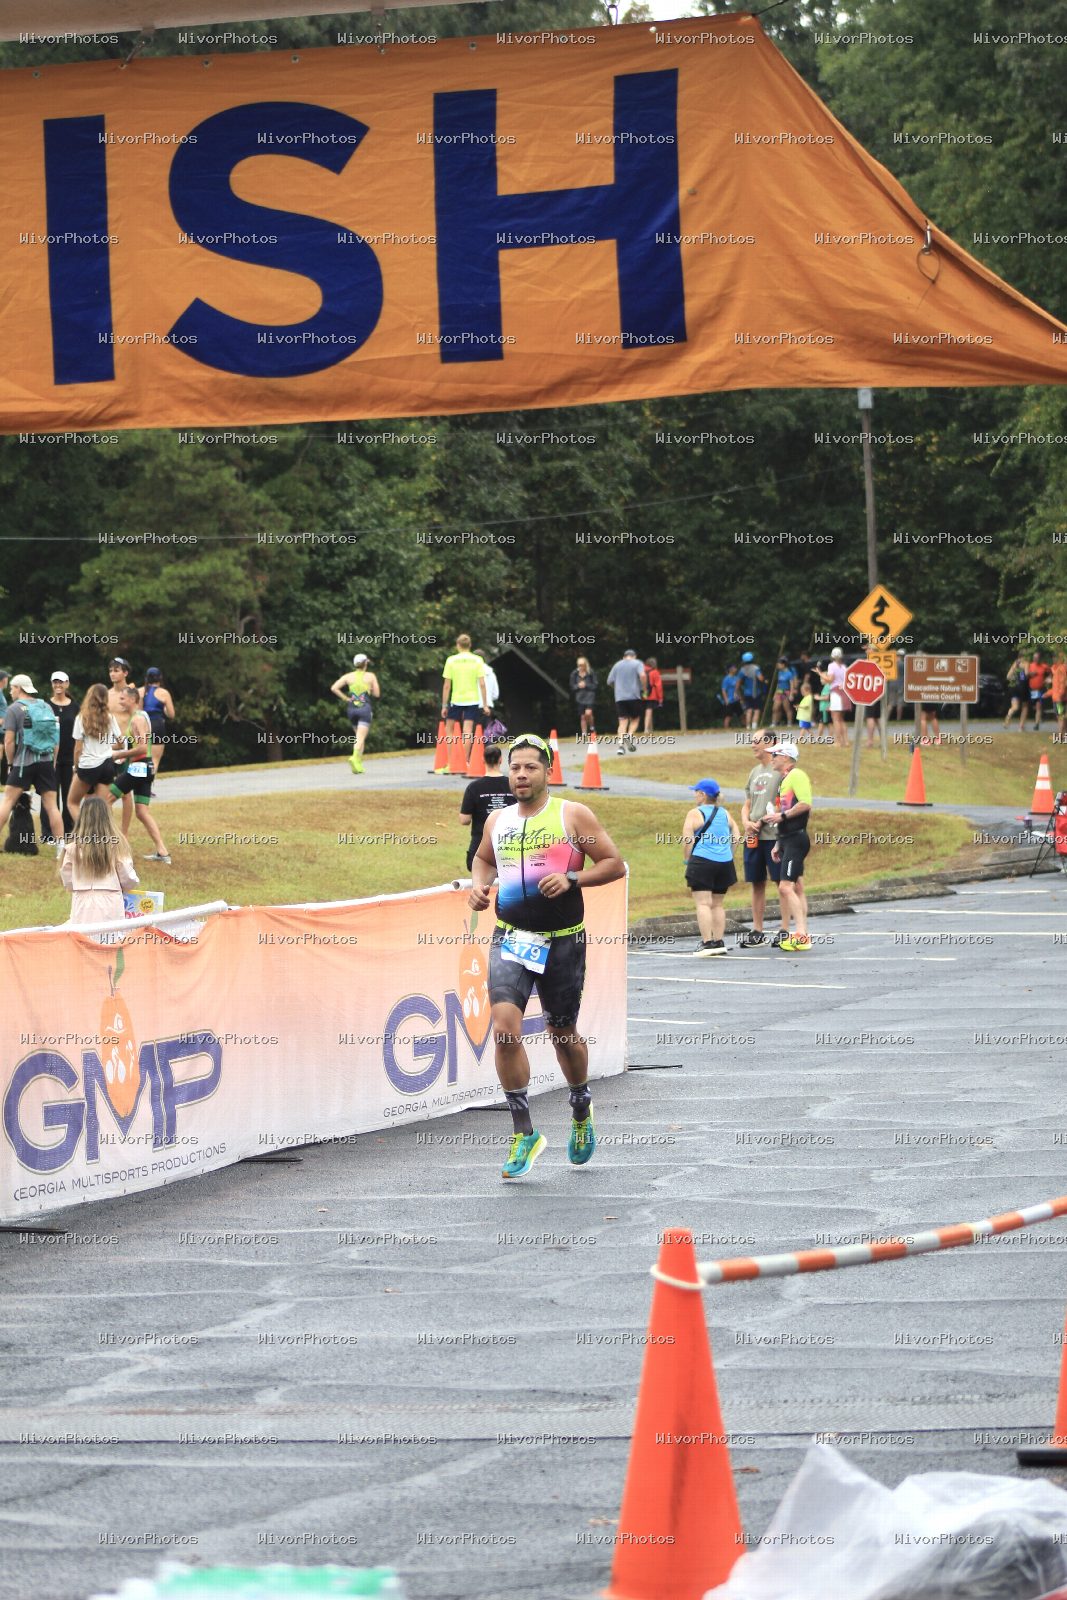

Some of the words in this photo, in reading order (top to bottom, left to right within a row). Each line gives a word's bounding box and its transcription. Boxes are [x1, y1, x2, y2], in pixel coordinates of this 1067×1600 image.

[43, 68, 687, 386] ISH
[846, 672, 883, 692] STOP
[941, 684, 960, 692] Nature
[961, 684, 974, 692] Trail
[3, 1028, 223, 1174] GMP
[383, 1100, 428, 1118] GEORGIA
[431, 1086, 494, 1108] MULTISPORTS
[71, 1165, 149, 1190] MULTISPORTS
[151, 1142, 227, 1174] PRODUCTIONS
